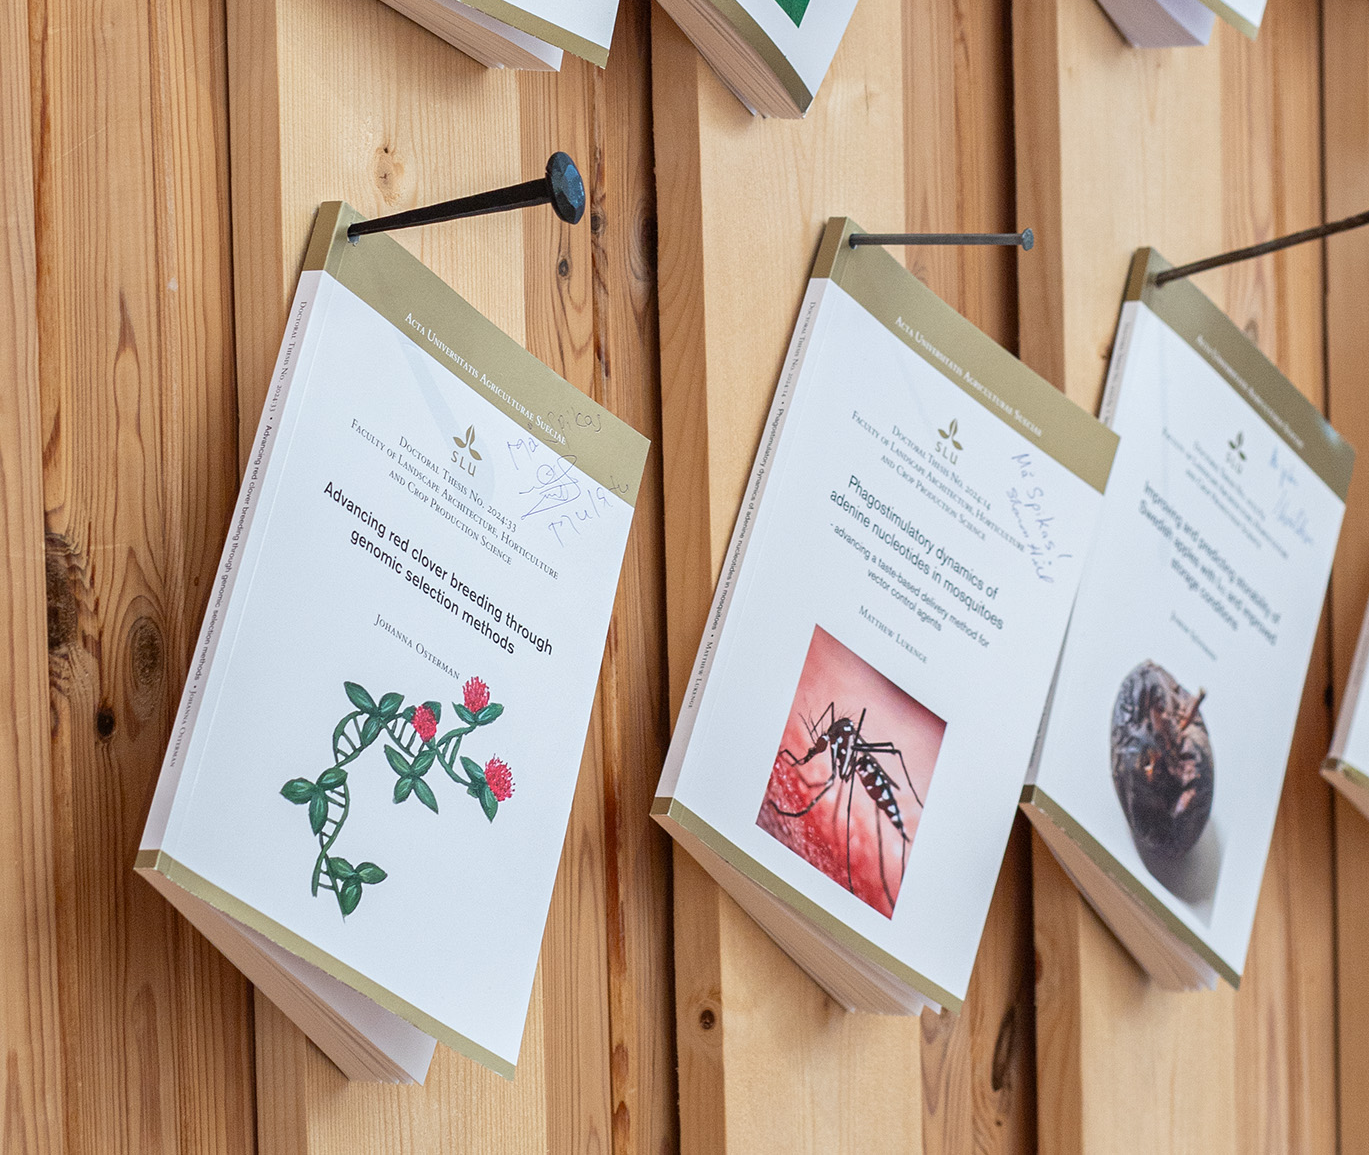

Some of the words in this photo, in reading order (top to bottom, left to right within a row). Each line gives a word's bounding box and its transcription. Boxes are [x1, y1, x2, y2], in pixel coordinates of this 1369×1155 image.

[450, 450, 476, 477] SLU
[934, 440, 958, 466] SLU
[323, 481, 386, 538] Advancing
[388, 531, 410, 553] red
[411, 548, 448, 580] clover
[449, 572, 503, 623] breeding
[505, 612, 552, 655] through
[350, 530, 403, 574] genomic
[404, 569, 459, 615] selection
[461, 610, 515, 654] methods
[829, 490, 871, 528] adenine
[871, 523, 930, 575] nucleotides
[931, 566, 942, 584] in
[942, 579, 1003, 630] mosquitoes
[833, 525, 871, 561] advancing
[870, 554, 877, 564] a
[877, 558, 921, 597] taste-based
[920, 592, 949, 619] delivery
[948, 614, 978, 640] method
[978, 633, 990, 648] for
[847, 474, 935, 555] Phagostimulatory
[935, 547, 984, 591] dynamics
[985, 586, 999, 599] of
[867, 569, 891, 591] vector
[890, 587, 917, 611] control
[916, 608, 942, 632] agents
